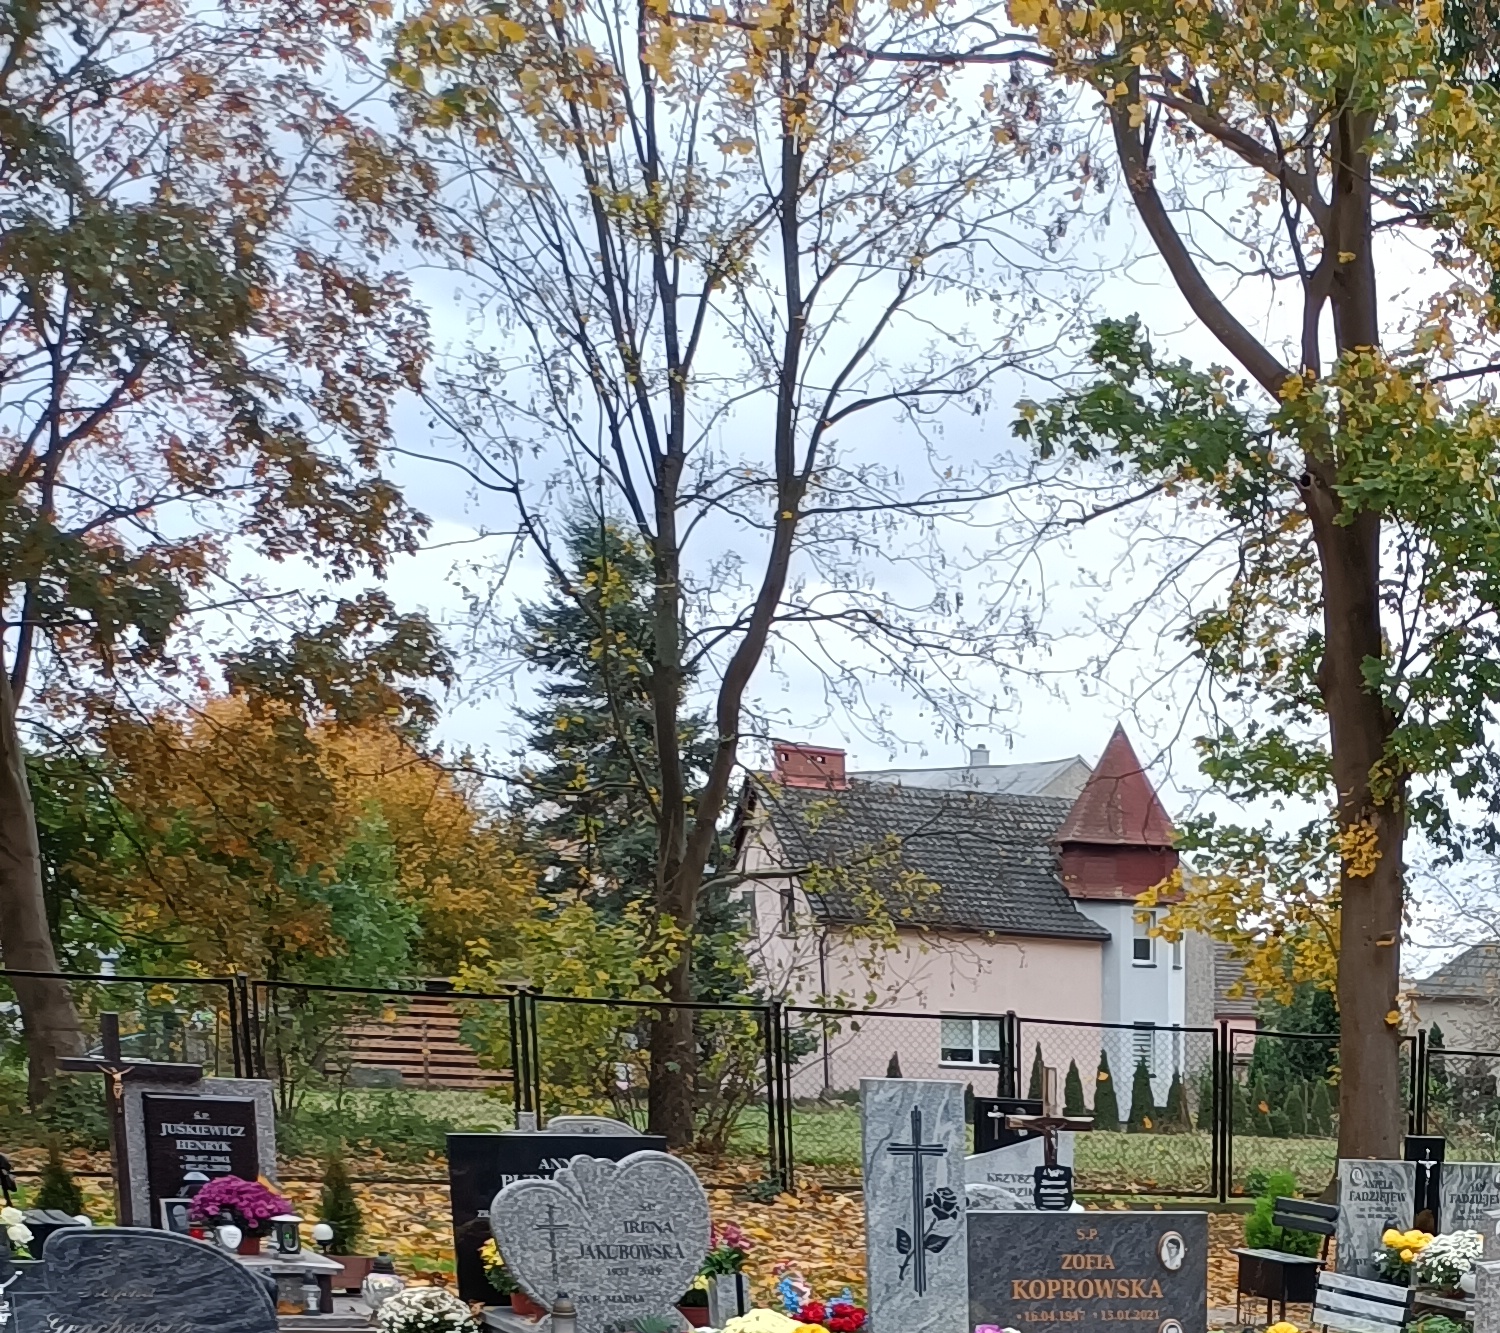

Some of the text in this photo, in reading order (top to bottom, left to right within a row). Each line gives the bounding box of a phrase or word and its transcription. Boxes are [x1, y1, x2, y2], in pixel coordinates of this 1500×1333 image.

[160, 1121, 246, 1137] JUŚKIEWICZ
[175, 1139, 232, 1152] HENRYK
[623, 1220, 674, 1234] IRENA
[578, 1243, 685, 1260] JAKUBOWSKA
[1061, 1254, 1115, 1270] ZOFIA
[1011, 1279, 1163, 1300] KOPROWSKA
